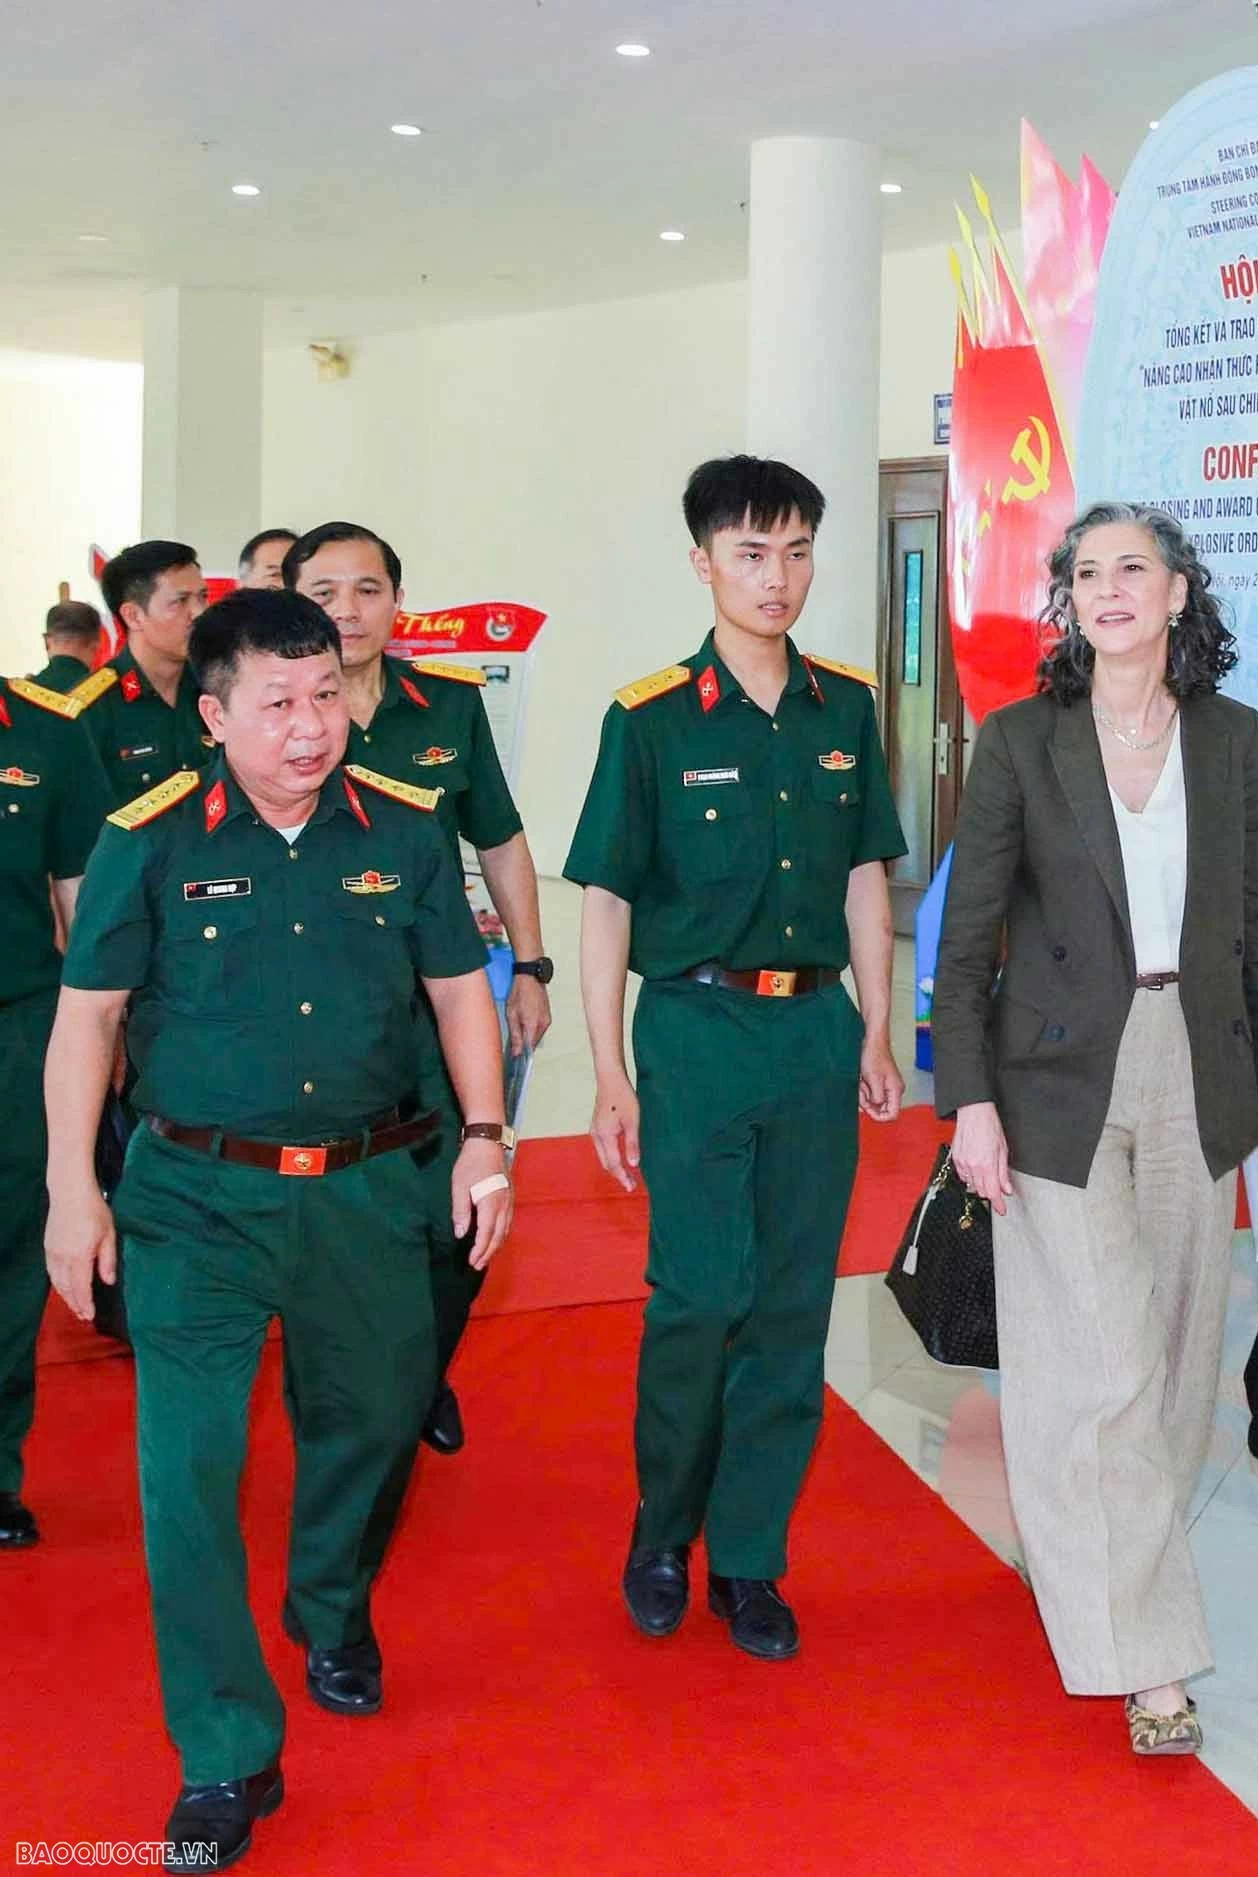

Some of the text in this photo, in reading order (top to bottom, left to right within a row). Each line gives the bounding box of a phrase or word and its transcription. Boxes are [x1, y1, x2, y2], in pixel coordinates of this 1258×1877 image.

[1157, 182, 1181, 199] TRUNG
[1210, 193, 1248, 214] STEERING
[1187, 220, 1221, 239] VIETNAM
[1230, 316, 1255, 340] TRAO
[1173, 363, 1192, 385] CAO
[1216, 394, 1236, 417] SAU
[1193, 497, 1212, 519] AND
[1216, 495, 1252, 518] AWARD
